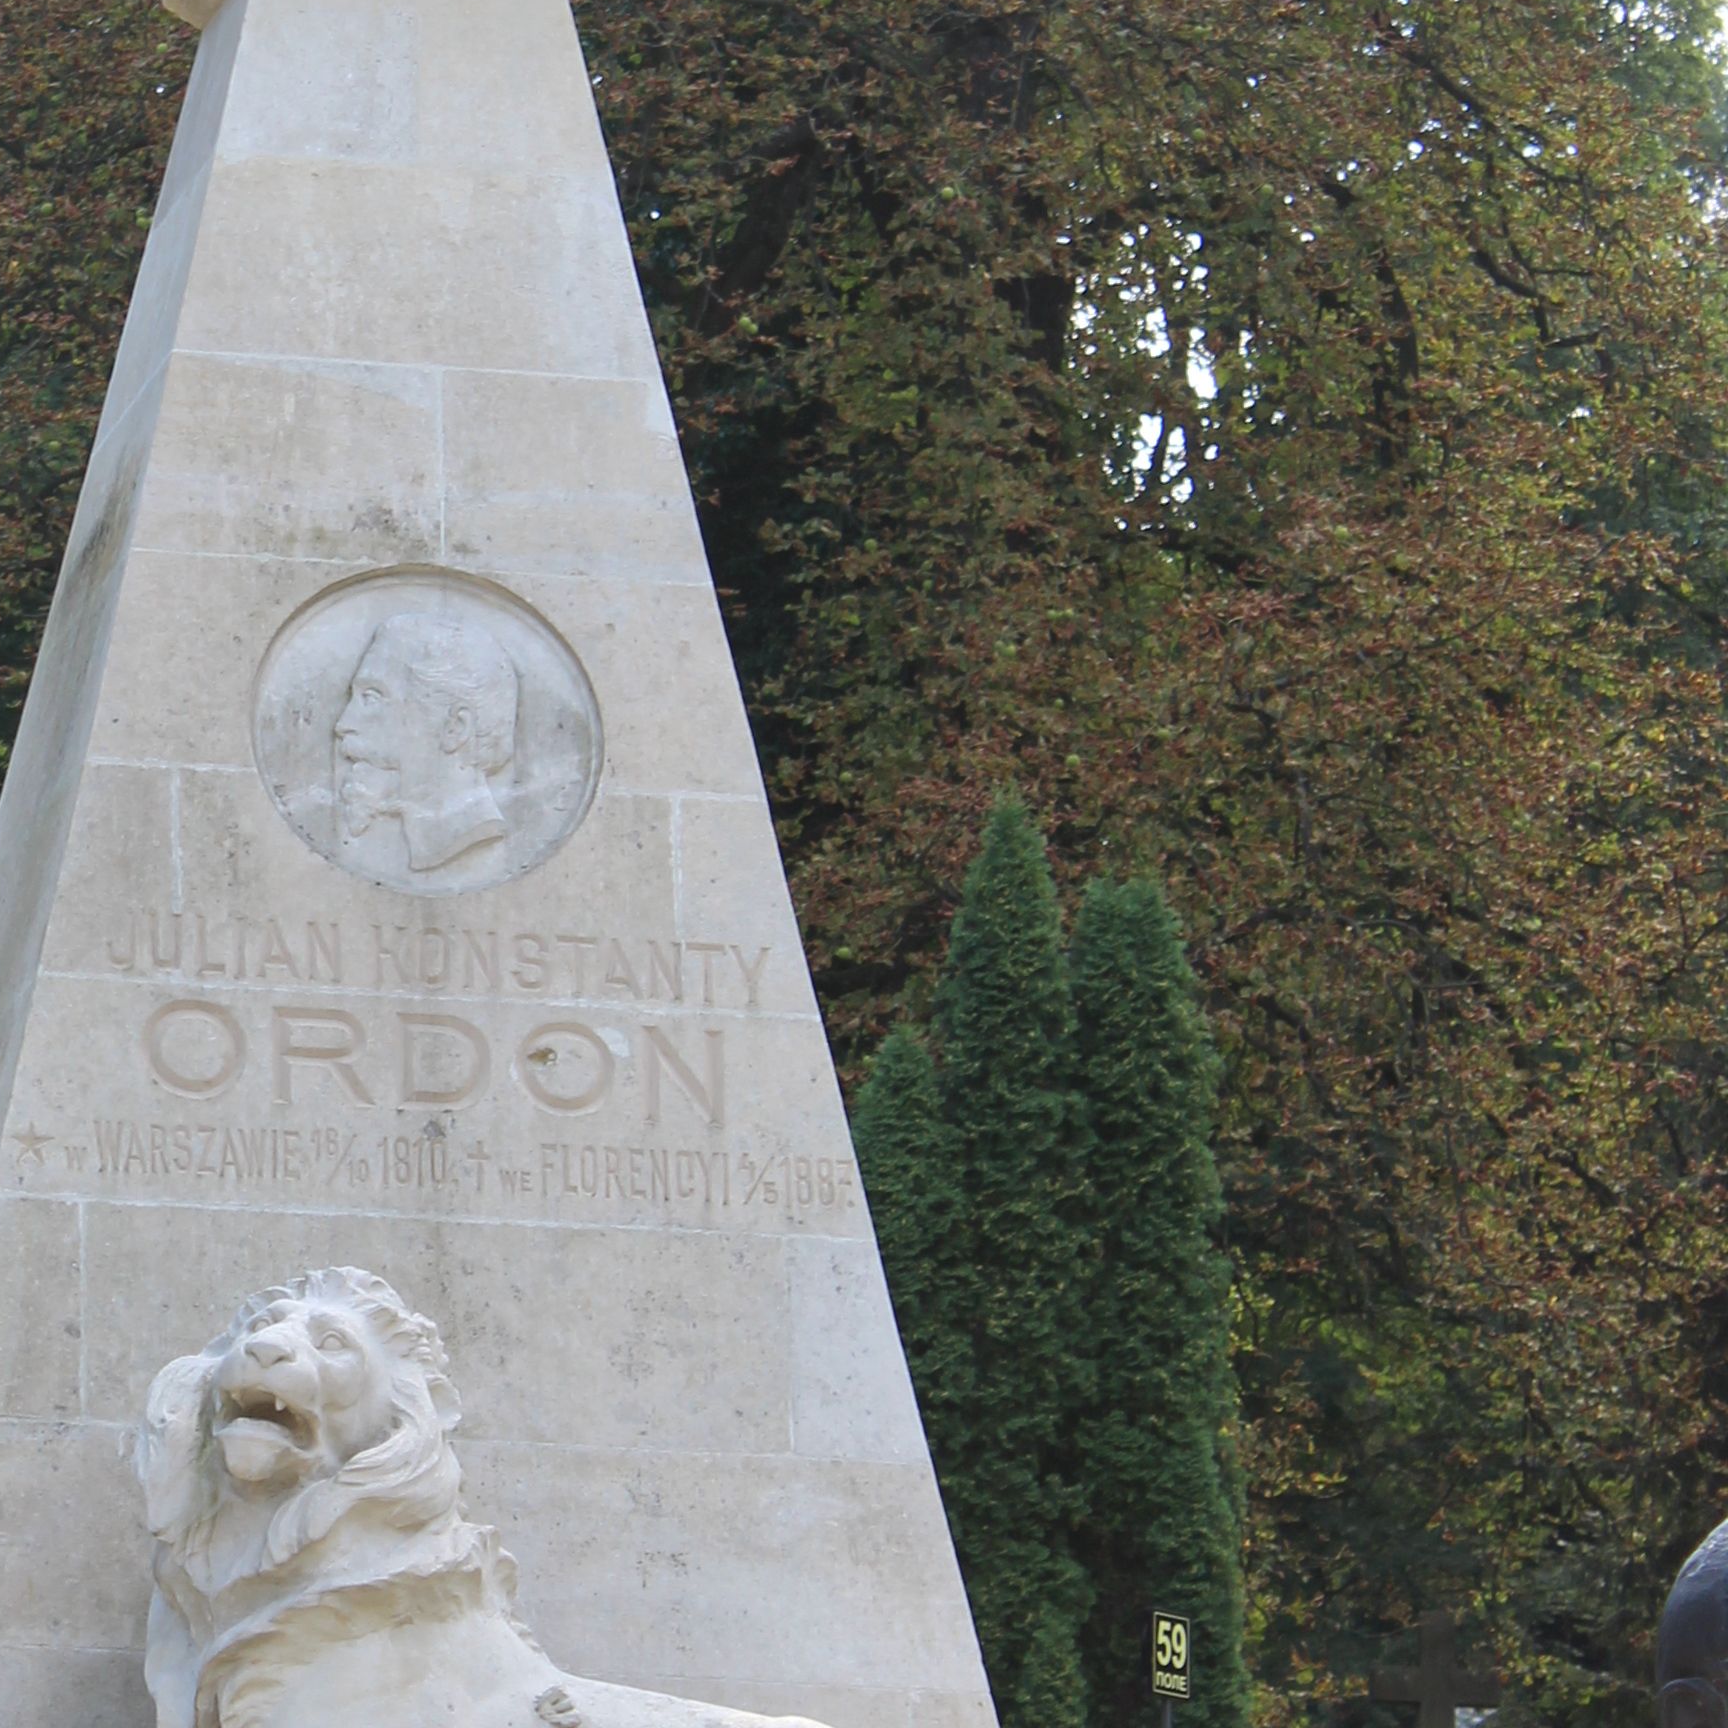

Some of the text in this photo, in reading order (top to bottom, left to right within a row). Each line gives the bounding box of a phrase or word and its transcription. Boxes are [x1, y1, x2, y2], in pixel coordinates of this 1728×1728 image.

[105, 910, 773, 1007] JULIAN KONSTANTY
[142, 998, 727, 1129] ORDON
[92, 1119, 302, 1181] WARSZAWIE
[539, 1142, 732, 1207] FLORENCYI
[1155, 1671, 1188, 1692] ПОЛЕ
[1156, 1619, 1187, 1670] 59
